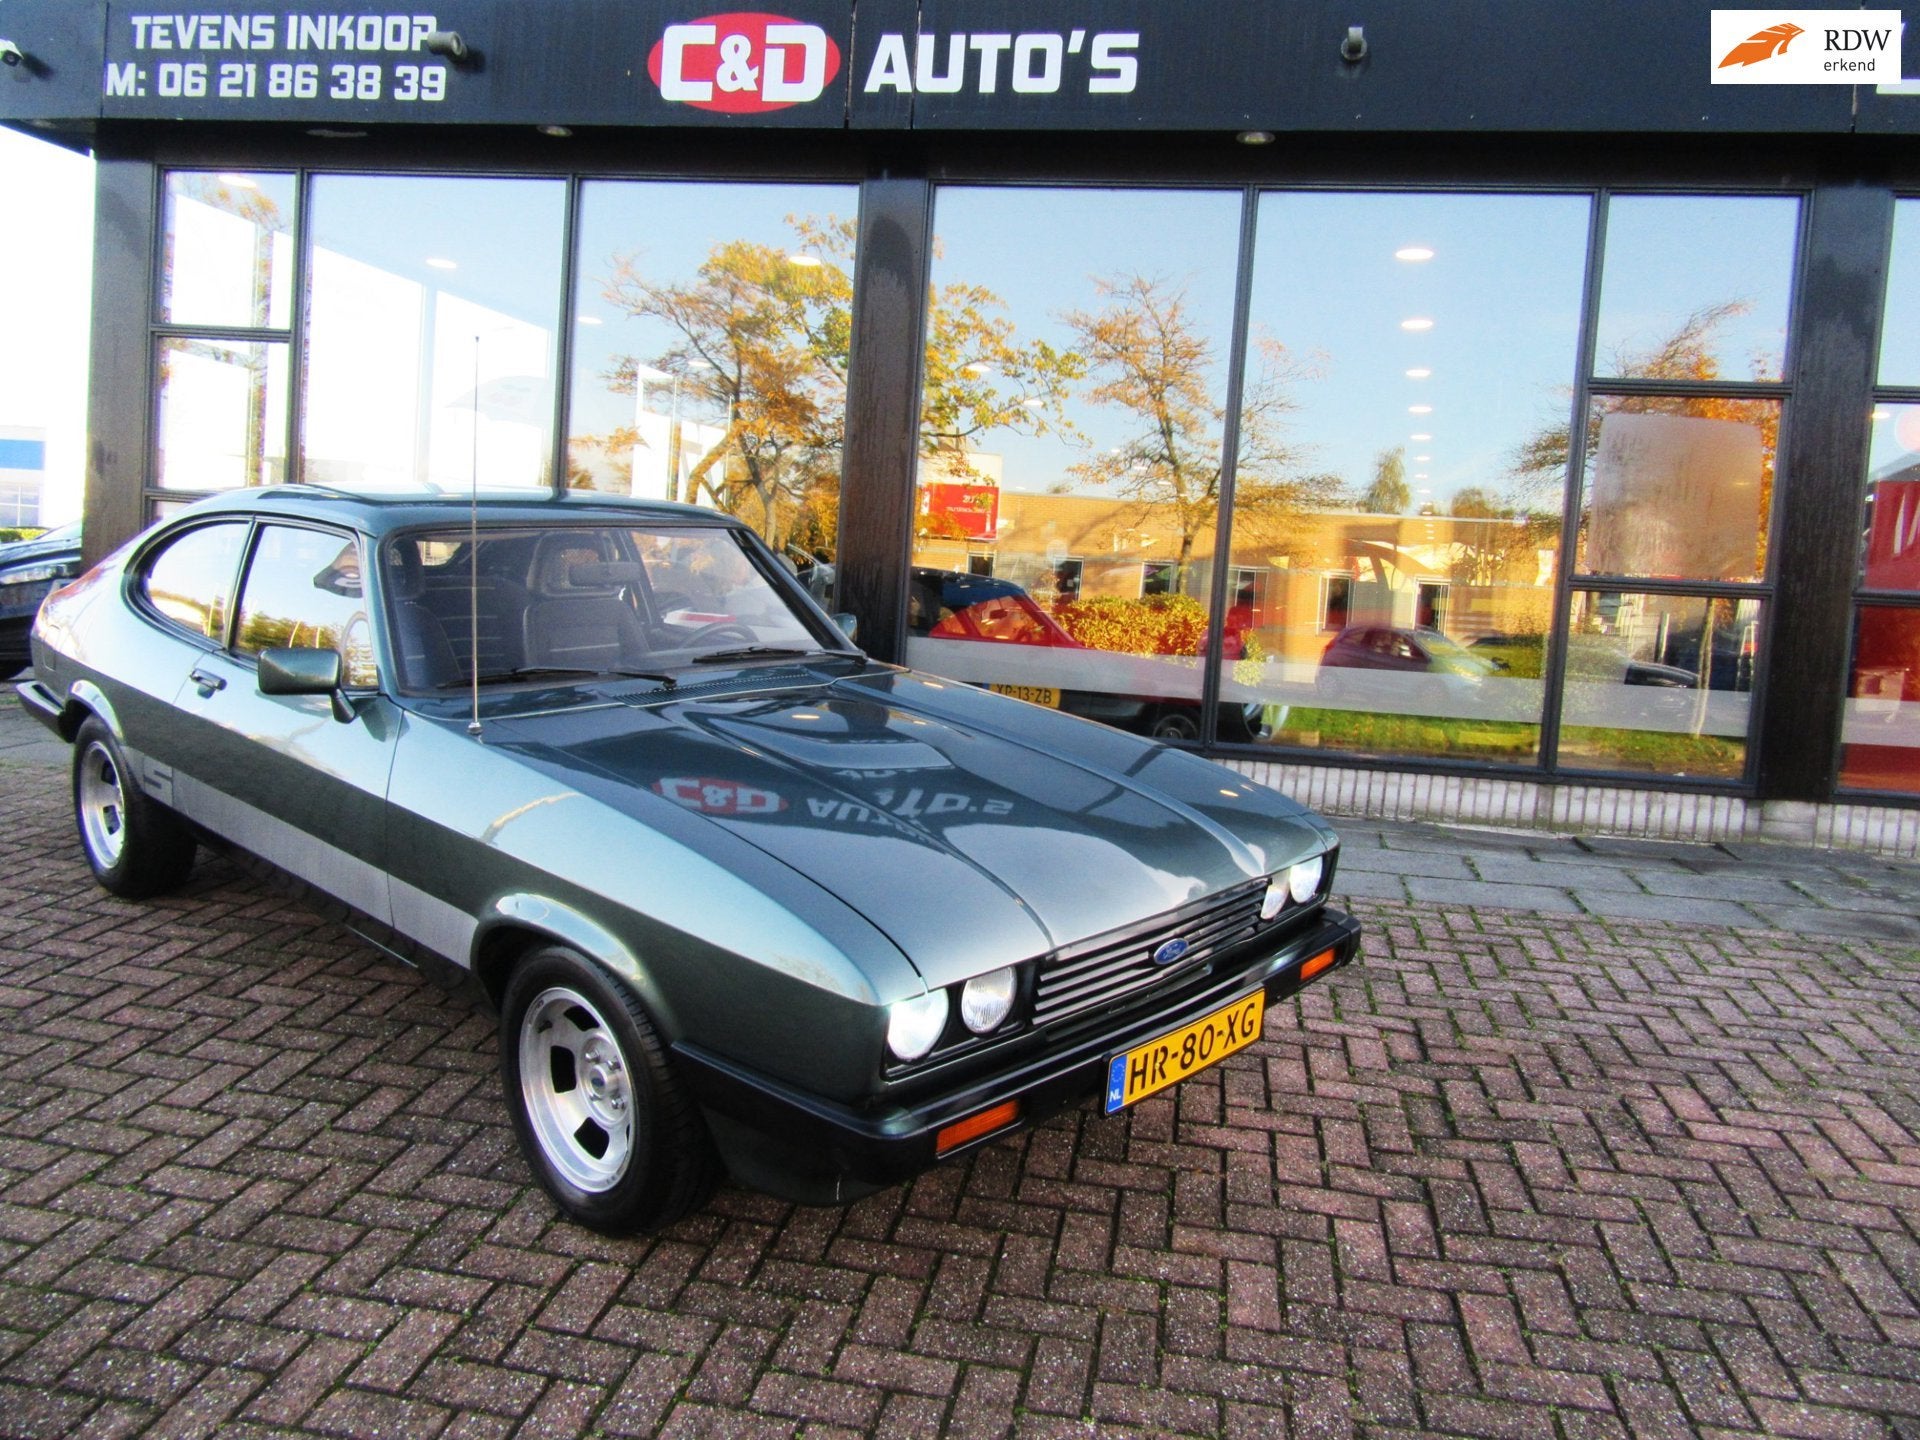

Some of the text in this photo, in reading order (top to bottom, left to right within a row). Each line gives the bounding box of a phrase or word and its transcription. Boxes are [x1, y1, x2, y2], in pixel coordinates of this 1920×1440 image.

[131, 15, 437, 51] TEVENS INKOOP
[106, 63, 446, 101] M: 06 21 86 38 39
[660, 24, 1140, 102] C&D AUTO'S
[1129, 1002, 1256, 1096] HR-80-XG
[1109, 1088, 1122, 1102] NL
